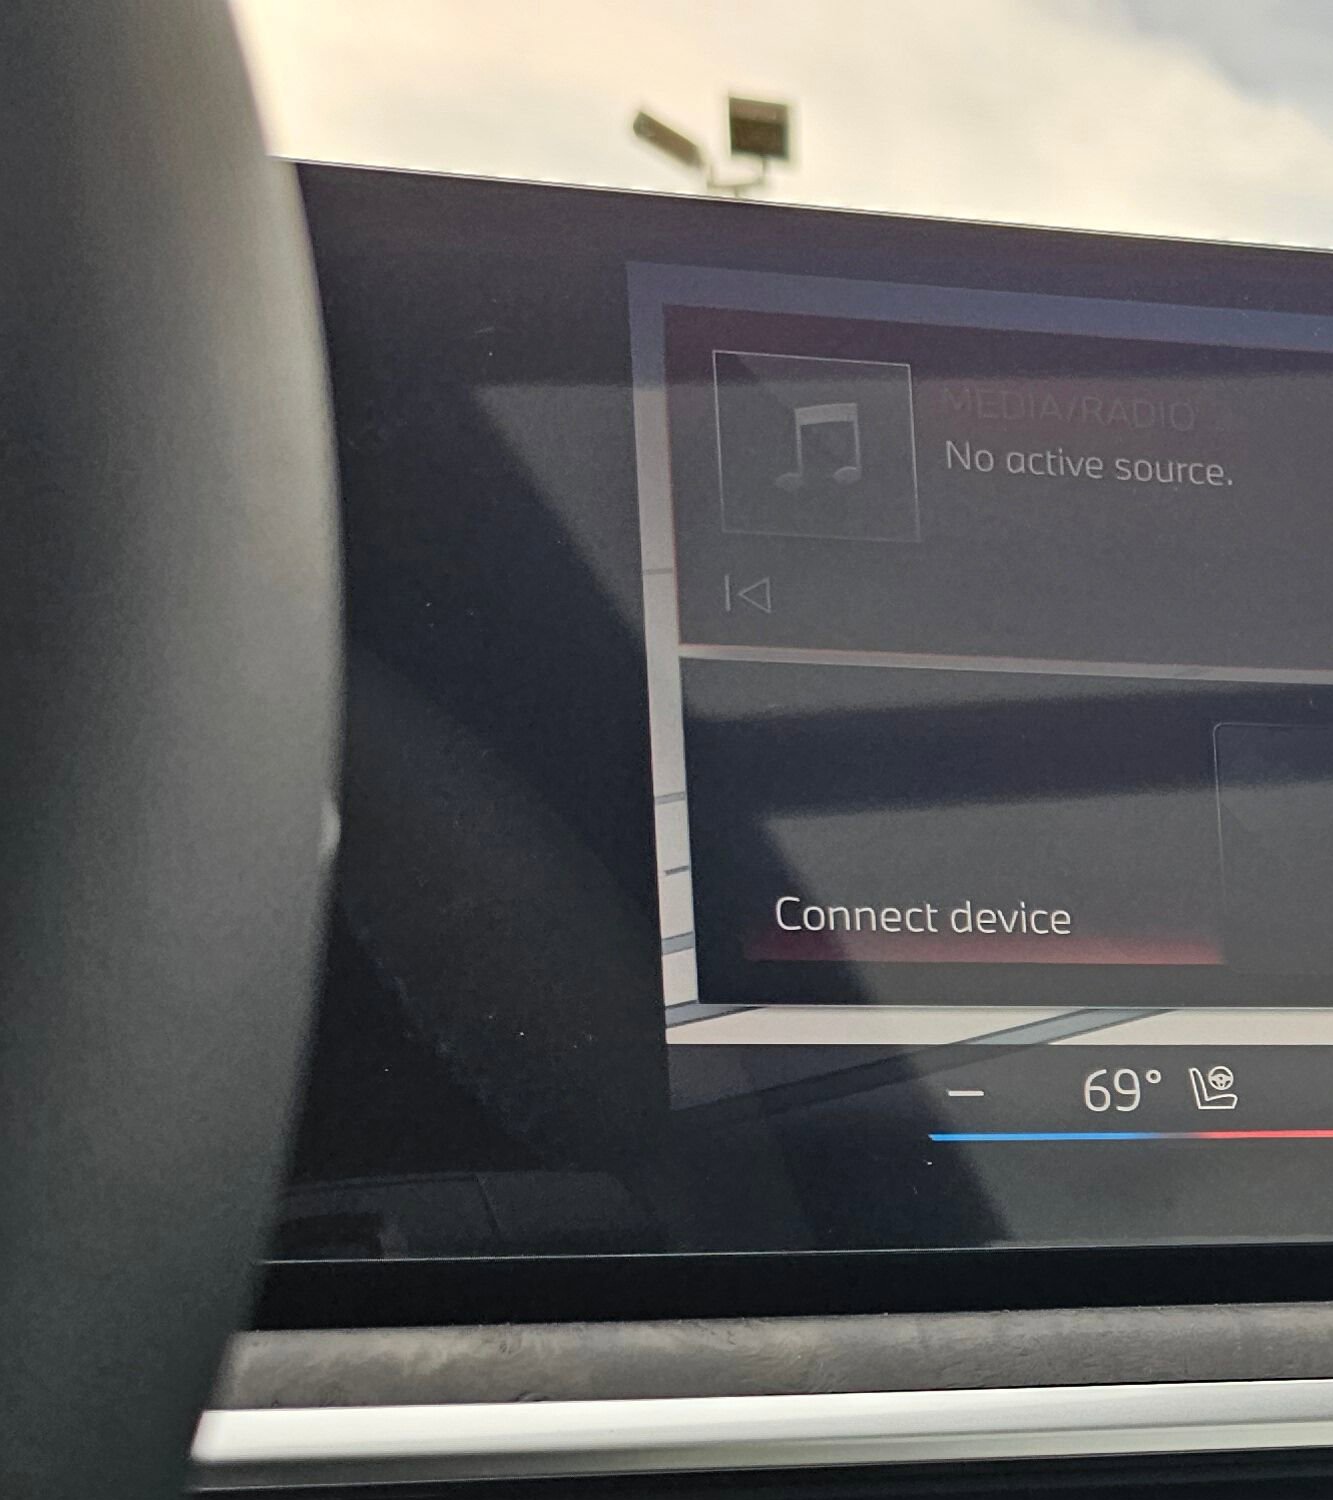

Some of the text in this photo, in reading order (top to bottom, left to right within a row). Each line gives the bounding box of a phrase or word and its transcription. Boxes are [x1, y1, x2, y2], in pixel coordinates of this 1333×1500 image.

[940, 384, 1197, 432] MEDIA/RADIO
[945, 439, 1233, 487] No active source.
[774, 895, 1072, 935] Connect device
[1083, 1068, 1162, 1112] 69°
